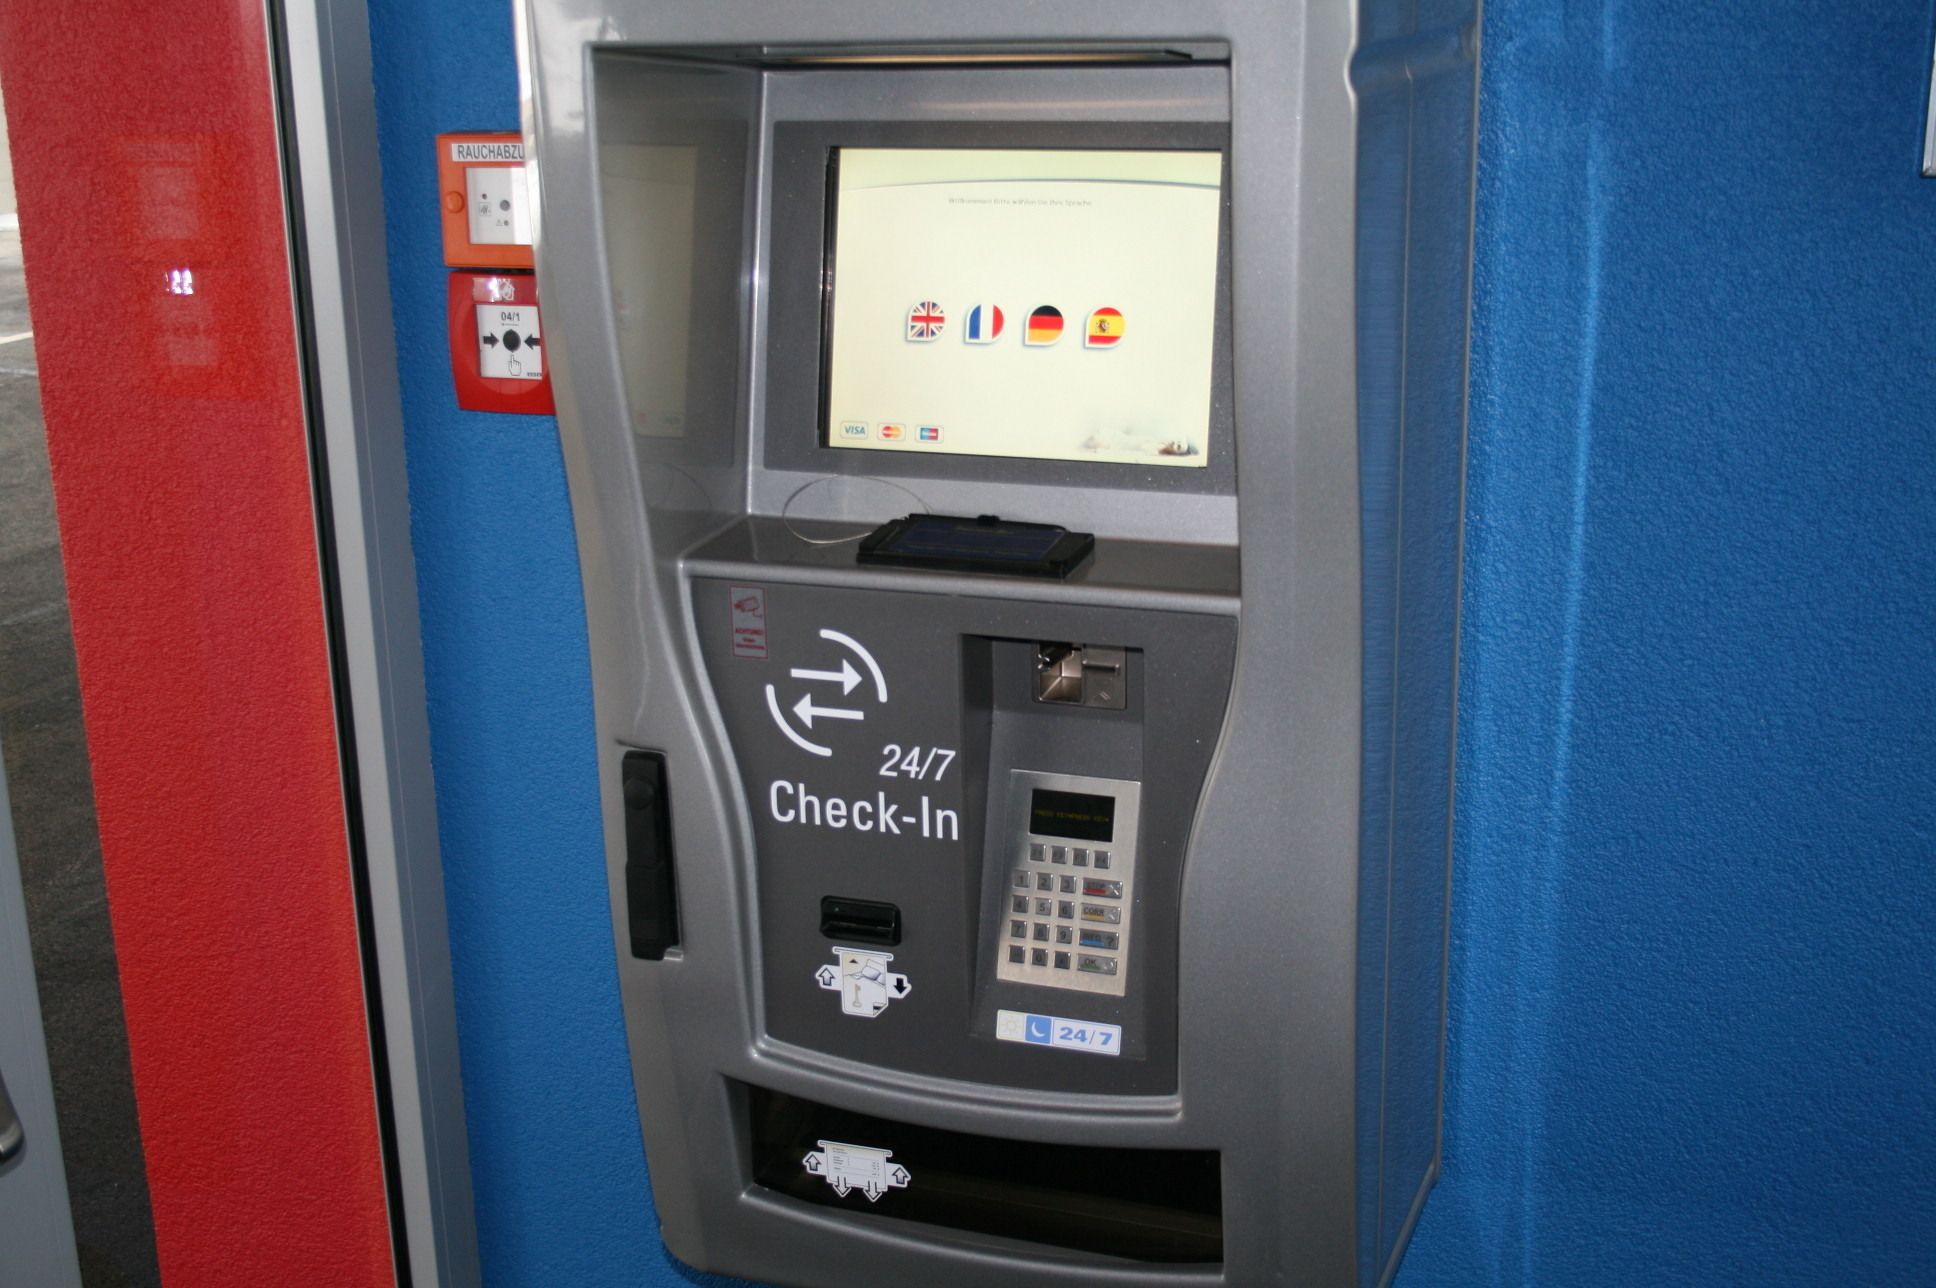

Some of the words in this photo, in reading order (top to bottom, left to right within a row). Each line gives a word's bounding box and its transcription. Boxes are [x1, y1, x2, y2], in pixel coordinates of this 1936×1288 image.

[500, 311, 520, 321] 04/1
[844, 425, 866, 436] VISA
[879, 744, 956, 781] 24/7
[770, 779, 959, 840] Check-In
[1059, 1026, 1113, 1046] 24/7
